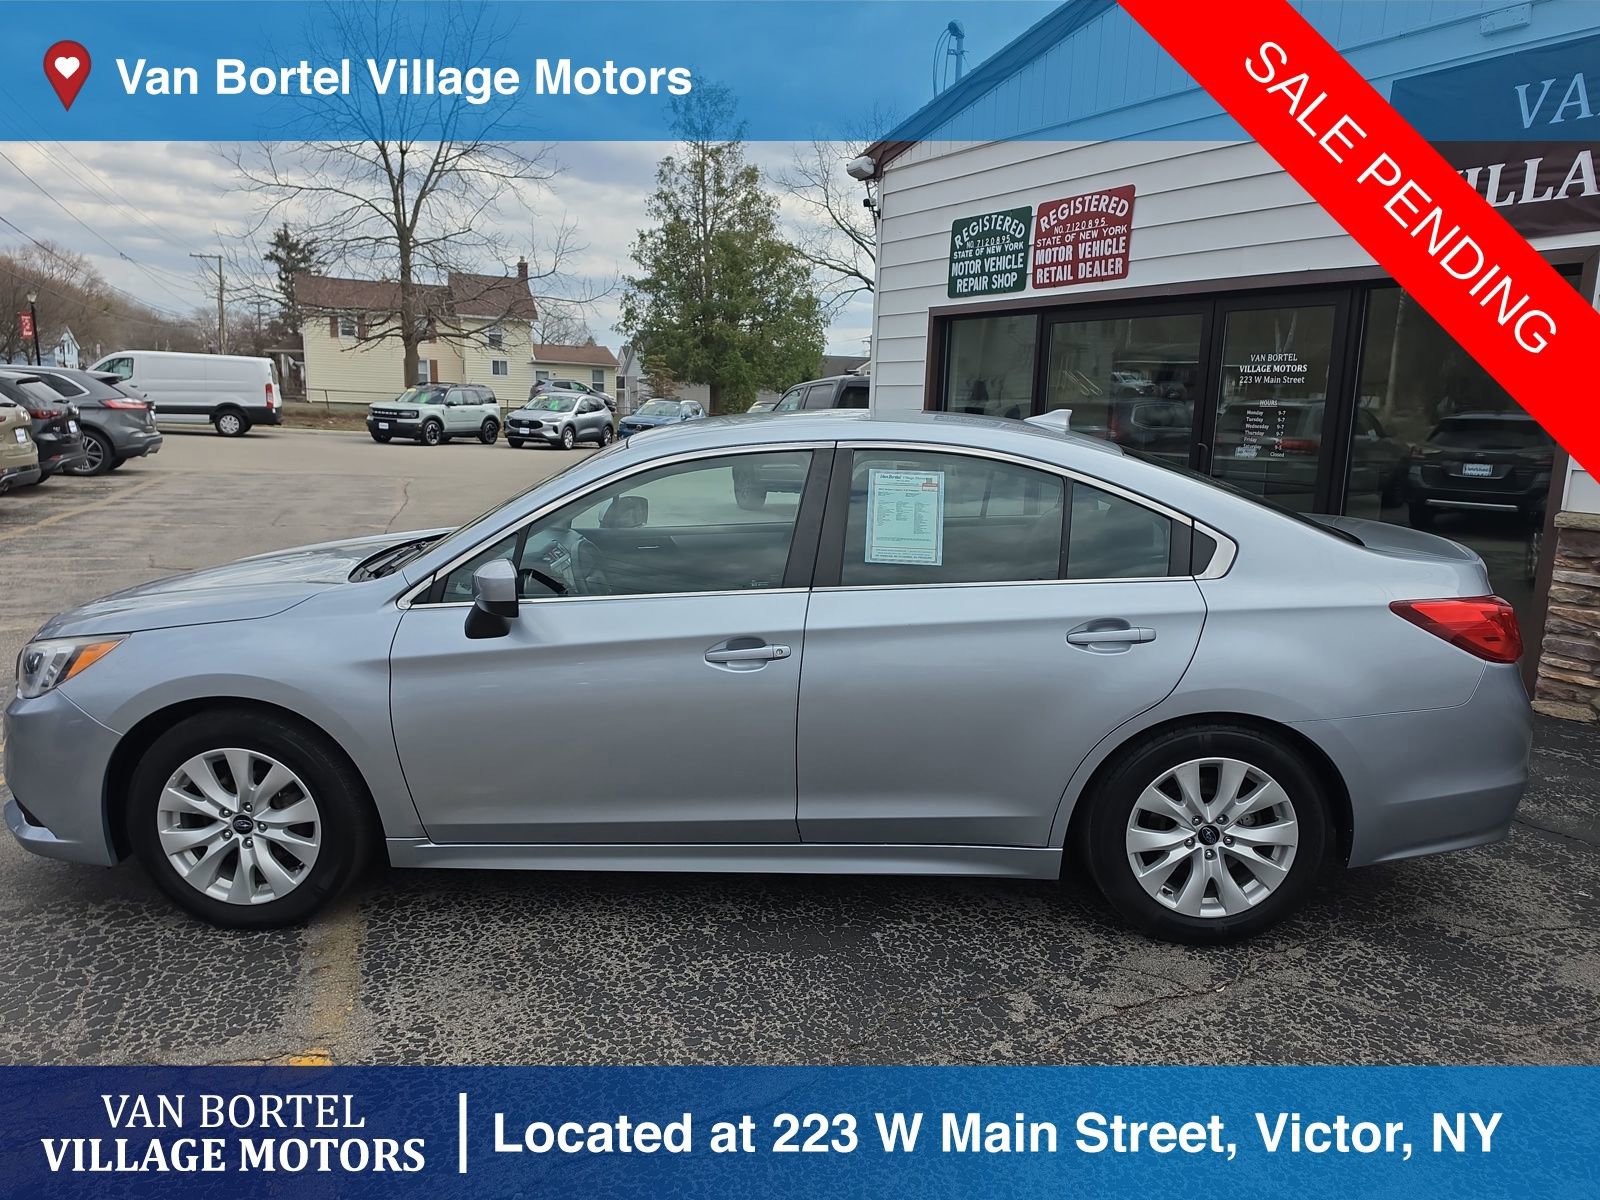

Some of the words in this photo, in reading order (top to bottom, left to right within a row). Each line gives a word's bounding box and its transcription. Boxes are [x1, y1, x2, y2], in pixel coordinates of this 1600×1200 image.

[1514, 72, 1600, 129] VA
[1457, 149, 1600, 208] ILLA
[1040, 194, 1129, 232] REGISTERED
[954, 214, 1026, 249] REGISTERED
[1036, 235, 1062, 248] STATE
[1065, 233, 1077, 243] OF
[1079, 229, 1099, 241] NEW
[1102, 224, 1128, 237] YORK
[1065, 217, 1106, 233] 7120895
[953, 249, 974, 260] STATE
[975, 247, 985, 257] OF
[986, 244, 1002, 255] NEW
[1004, 241, 1024, 252] YORK
[977, 234, 1011, 248] 7120895
[1035, 245, 1073, 266] MOTOR
[1078, 236, 1126, 260] VEHICLE
[951, 259, 982, 277] MOTOR
[984, 252, 1025, 273] VEHICLE
[1036, 264, 1073, 285] RETAIL
[1077, 257, 1123, 279] DEALER
[956, 275, 989, 294] REPAIR
[991, 271, 1018, 290] SHOP
[1239, 364, 1272, 373] VILLAGE
[1272, 364, 1308, 373] MOTORS
[1250, 354, 1266, 362] VAN
[1267, 353, 1298, 362] BORTEL
[1239, 375, 1253, 384] 223
[1254, 375, 1262, 383] W
[1263, 375, 1281, 384] Main
[1282, 375, 1305, 384] Street
[1259, 399, 1278, 407] HOURS
